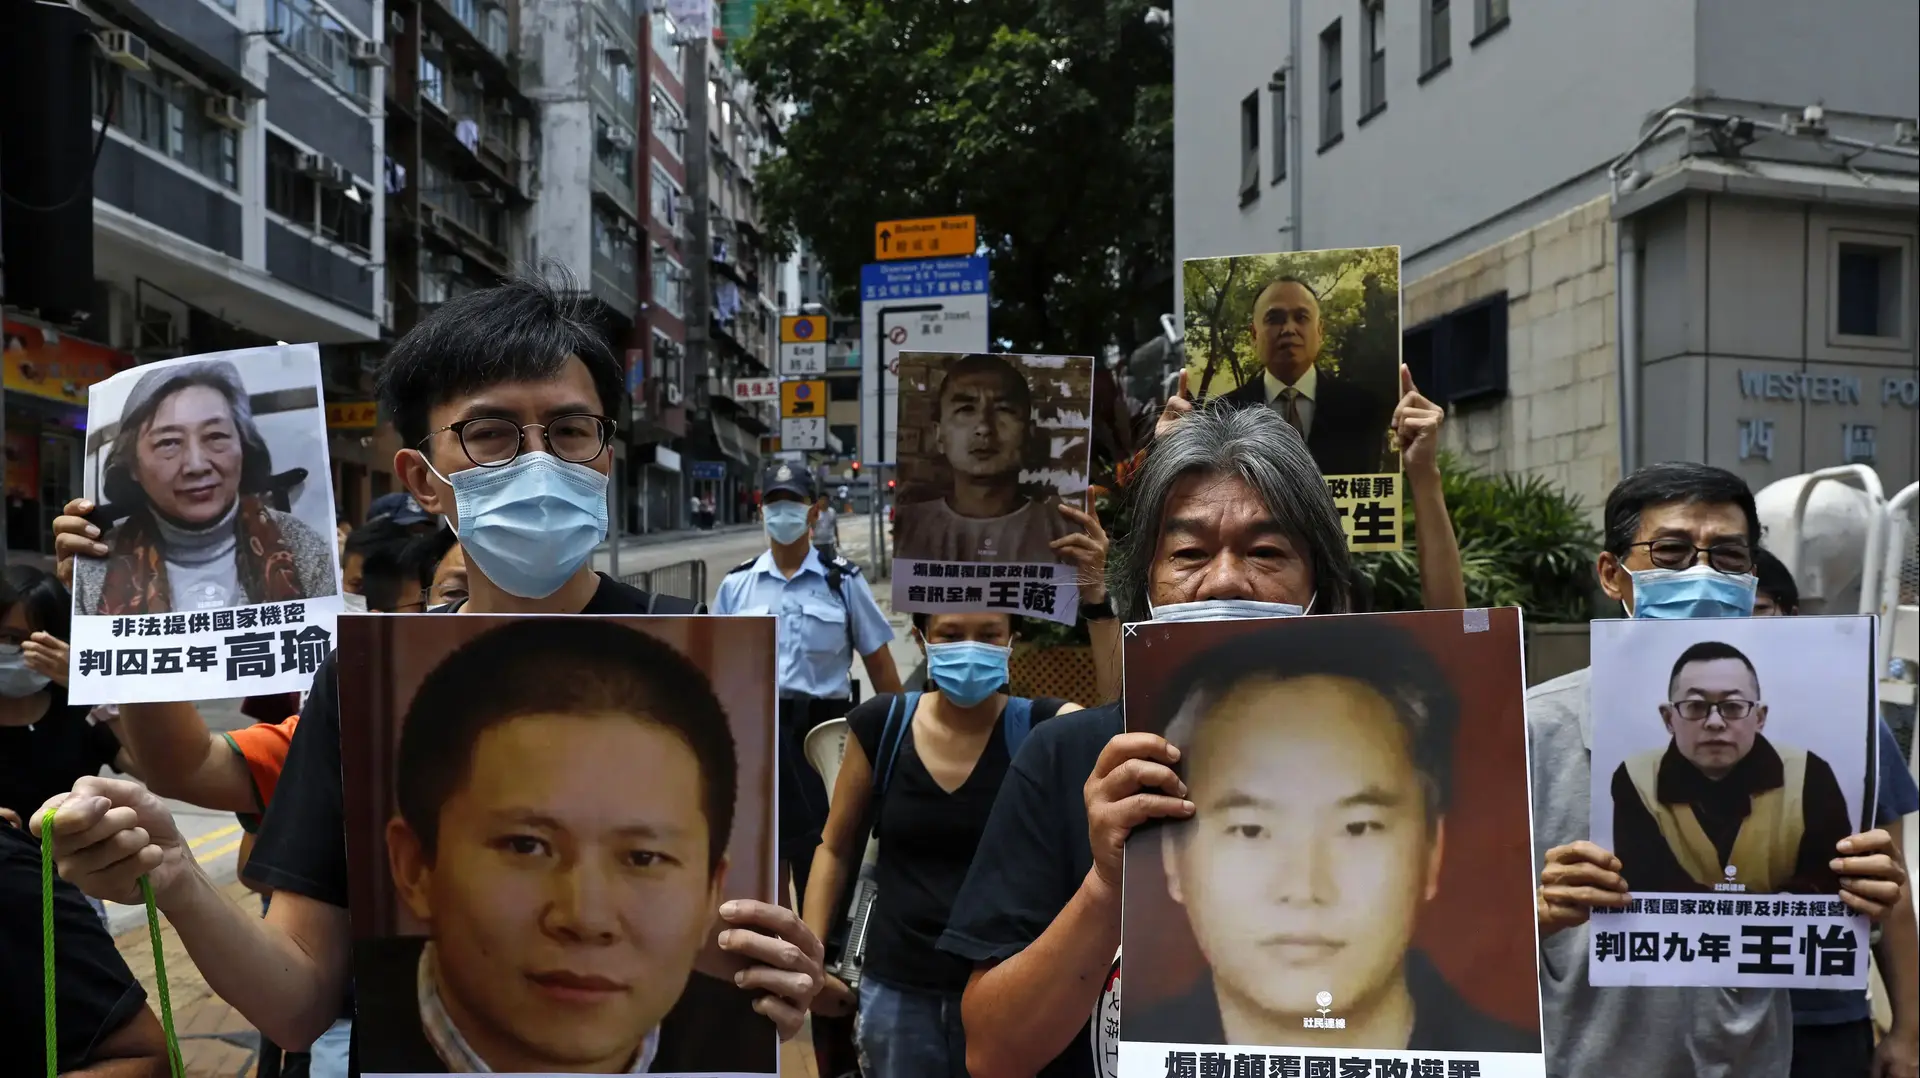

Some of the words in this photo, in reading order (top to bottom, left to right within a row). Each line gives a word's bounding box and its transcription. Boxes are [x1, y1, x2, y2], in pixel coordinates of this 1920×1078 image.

[941, 220, 967, 230] Road
[794, 346, 814, 356] End
[1739, 369, 1860, 405] WESTERN
[1336, 501, 1396, 544] 生
[908, 585, 983, 603] 音訊全無
[112, 603, 306, 637] 非法提供國家機密
[79, 646, 218, 677] 判囚五年
[224, 624, 332, 681] 高瑜
[1595, 932, 1731, 963] 判囚九年
[1737, 924, 1858, 977] 王怡
